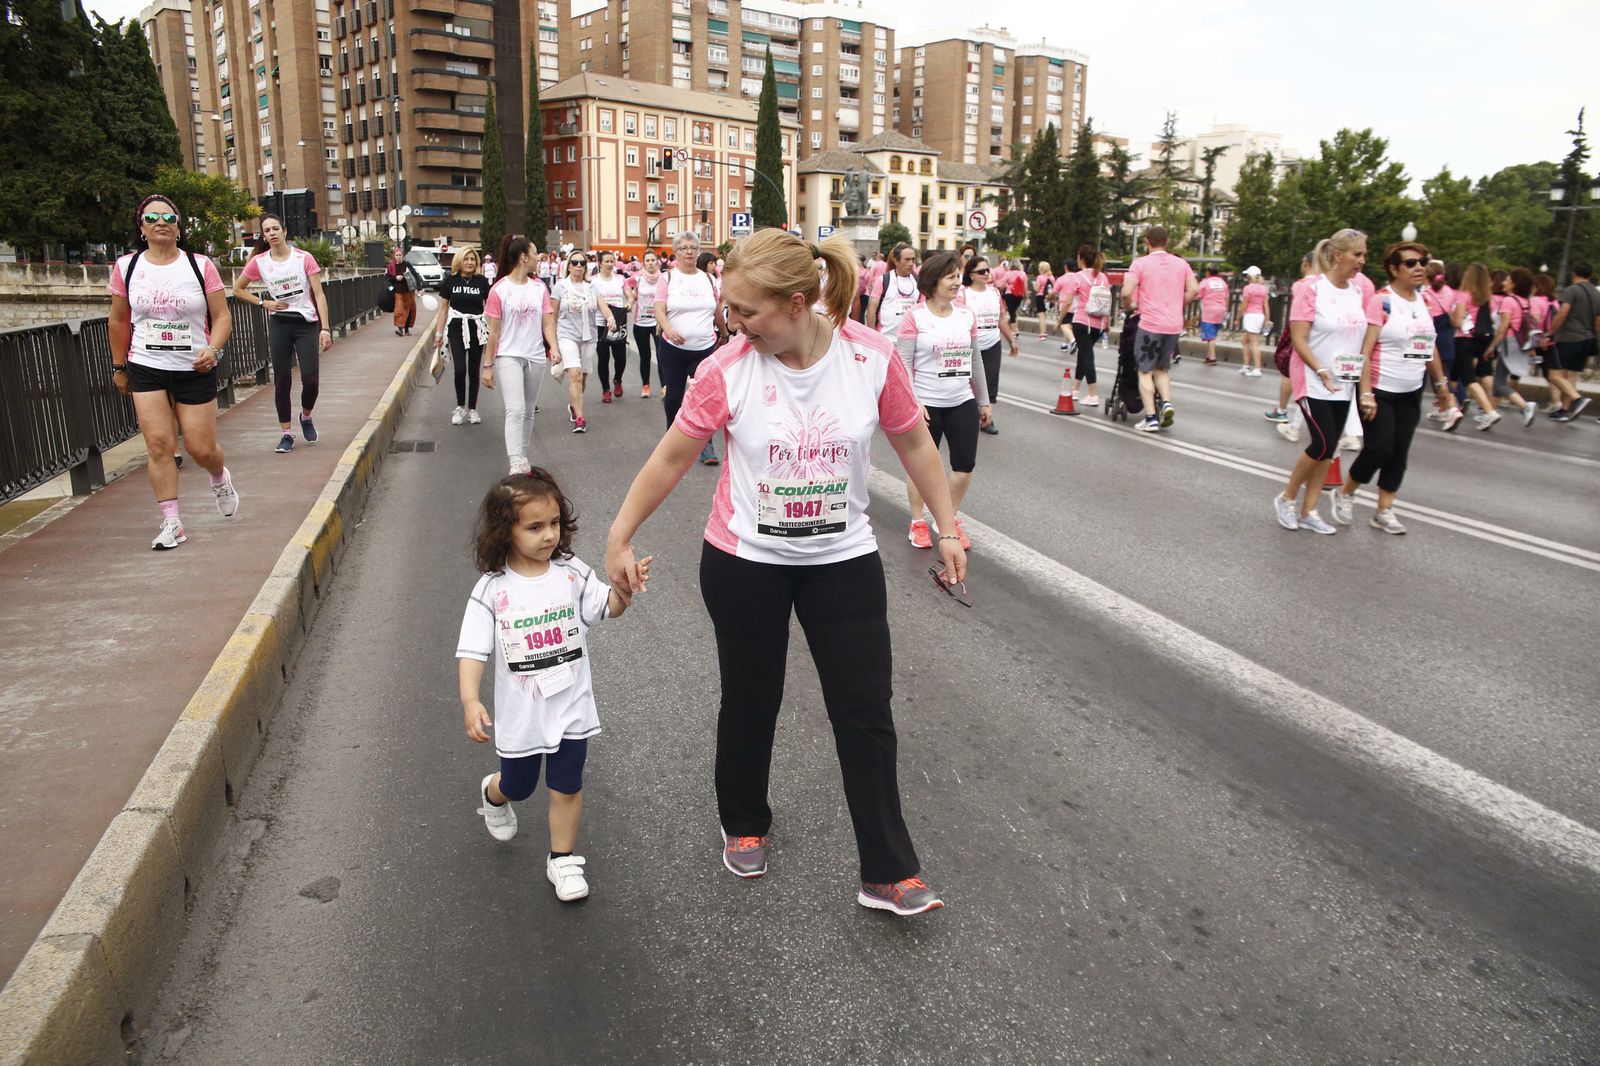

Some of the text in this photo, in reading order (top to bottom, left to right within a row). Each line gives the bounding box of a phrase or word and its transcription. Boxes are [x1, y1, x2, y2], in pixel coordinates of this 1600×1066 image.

[735, 213, 747, 227] P
[452, 286, 481, 295] LAS VEGAS
[161, 331, 174, 341] 98
[944, 359, 962, 368] 3299
[768, 444, 792, 464] Por
[809, 443, 851, 464] mujer
[774, 481, 848, 496] COVIRAN
[783, 500, 823, 519] 1947
[513, 607, 575, 629] COVIRAN
[524, 626, 563, 650] 1948
